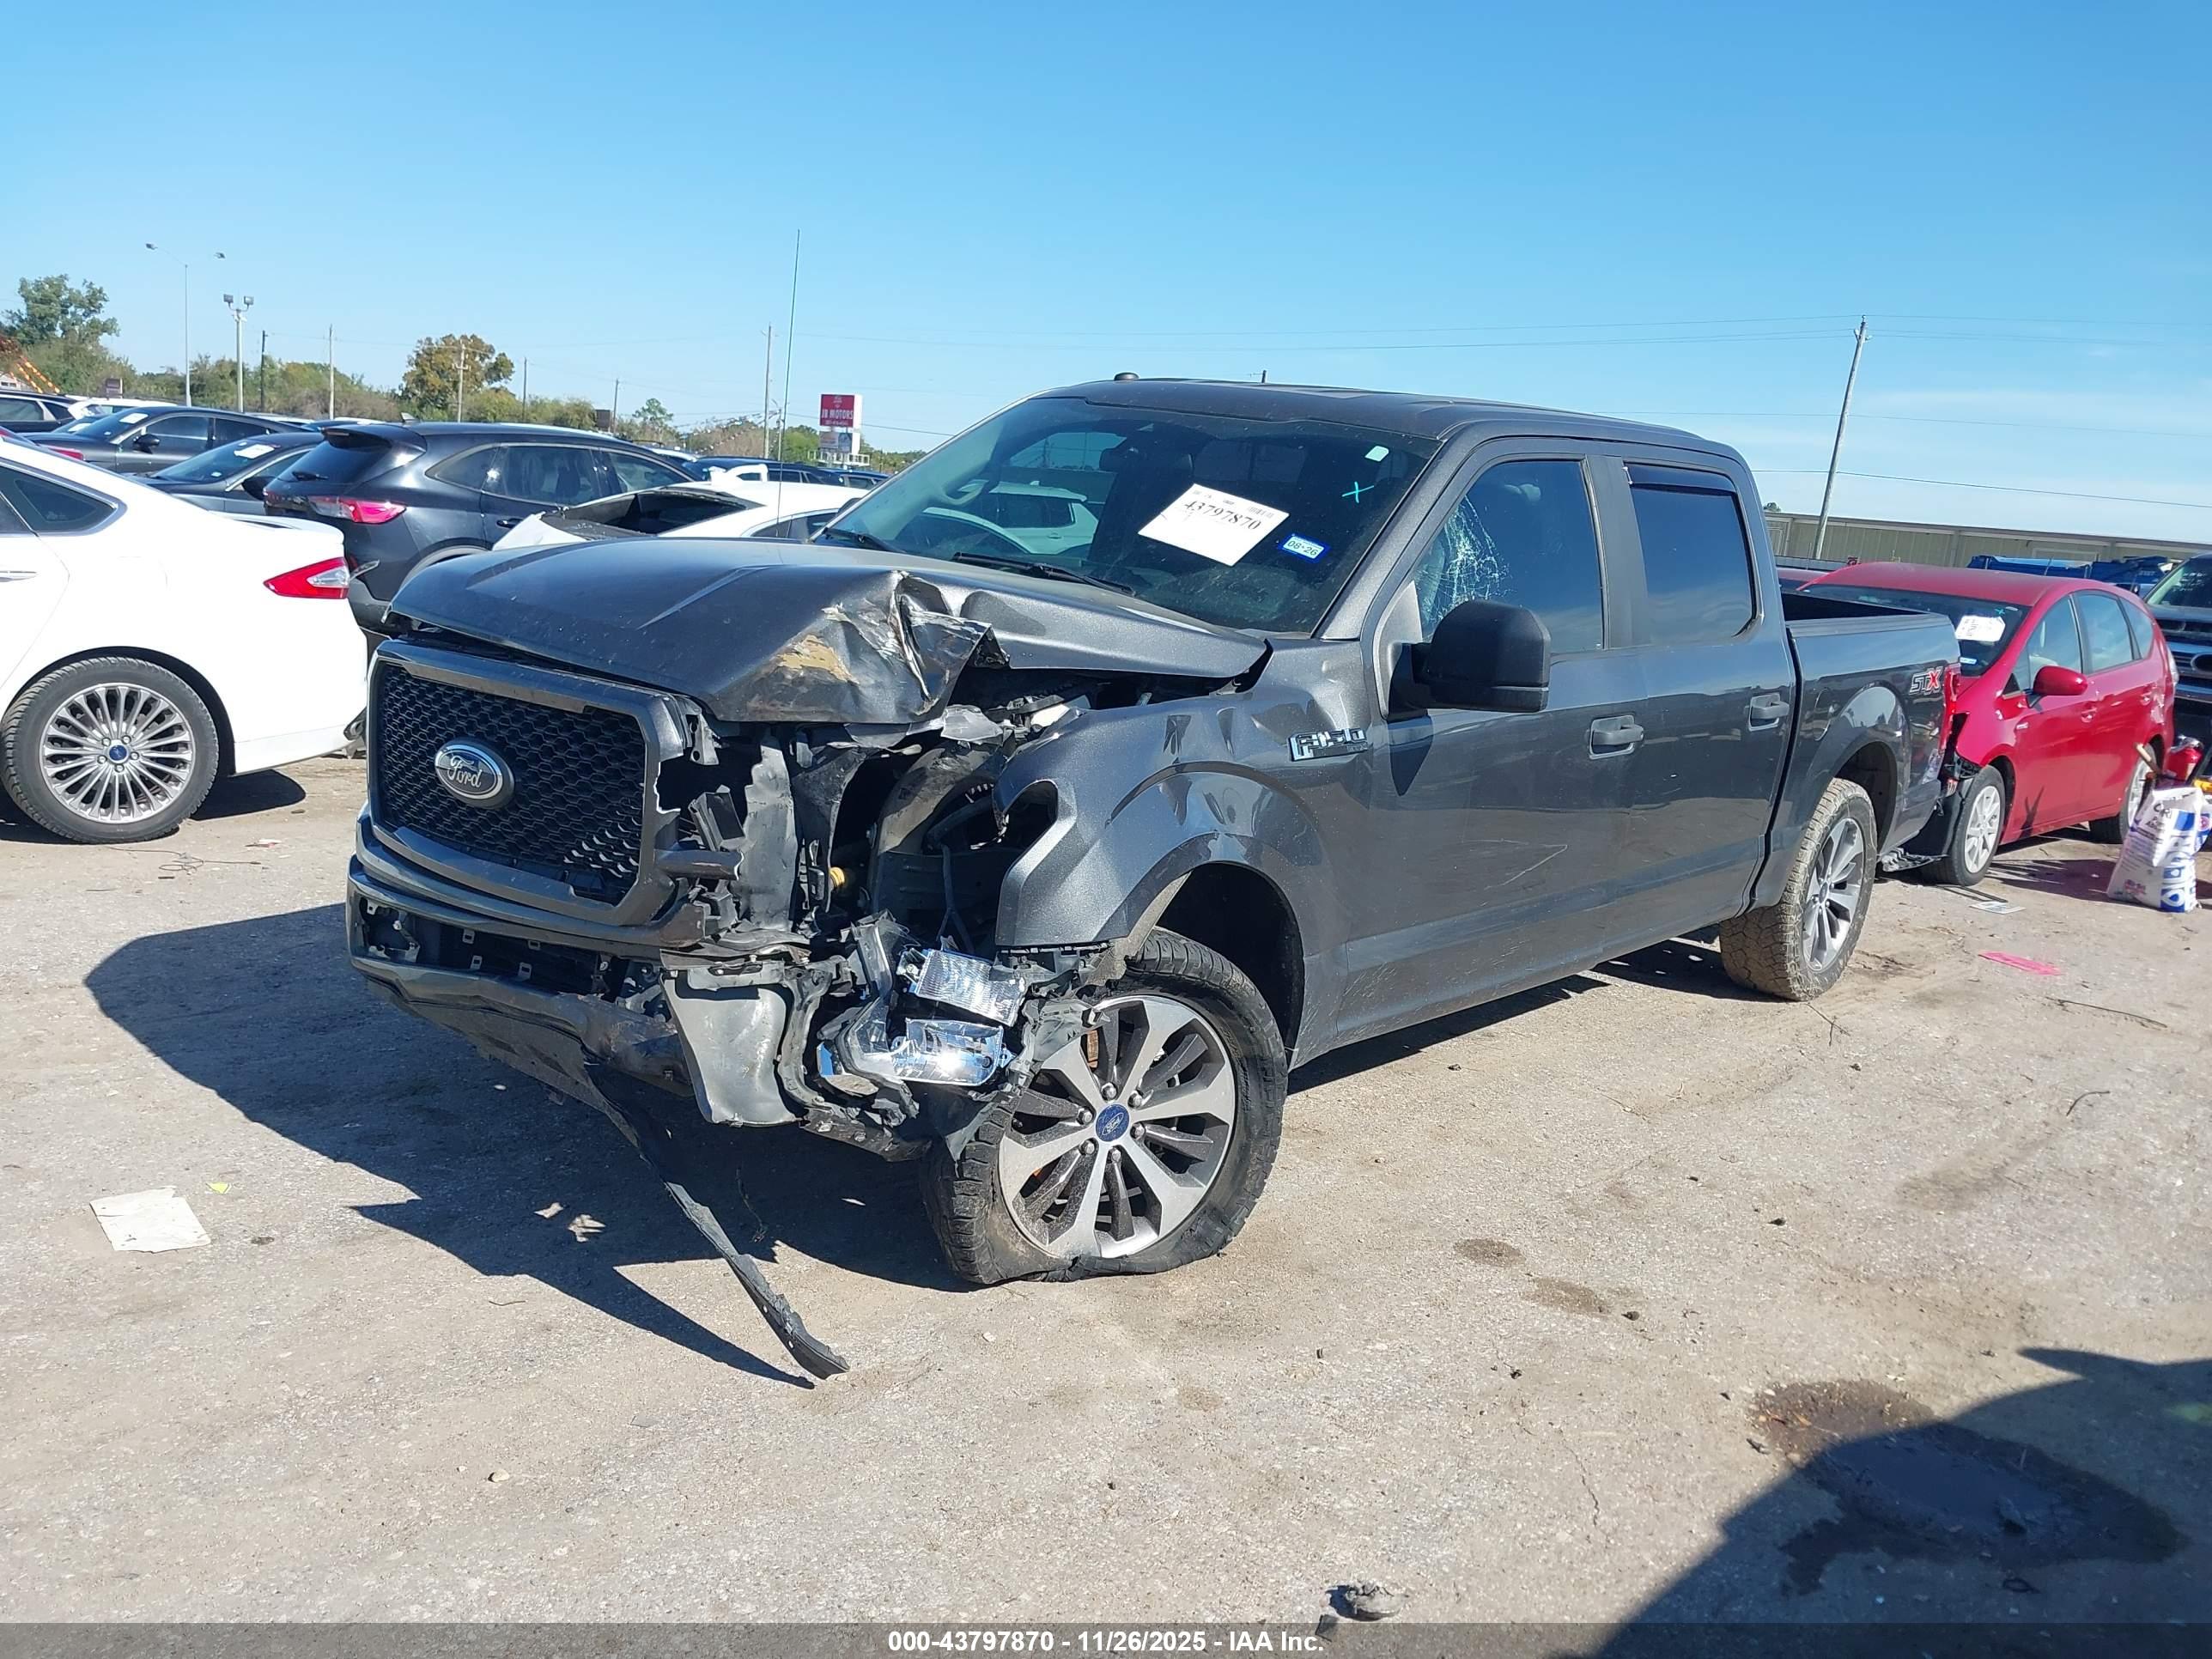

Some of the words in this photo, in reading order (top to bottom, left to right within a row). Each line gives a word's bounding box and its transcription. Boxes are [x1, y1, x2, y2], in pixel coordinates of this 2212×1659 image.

[830, 409, 853, 420] MOTORS
[1184, 501, 1261, 530] 43797870
[1909, 666, 1943, 696] STX
[1289, 729, 1366, 761] F-150
[447, 755, 483, 787] Ford
